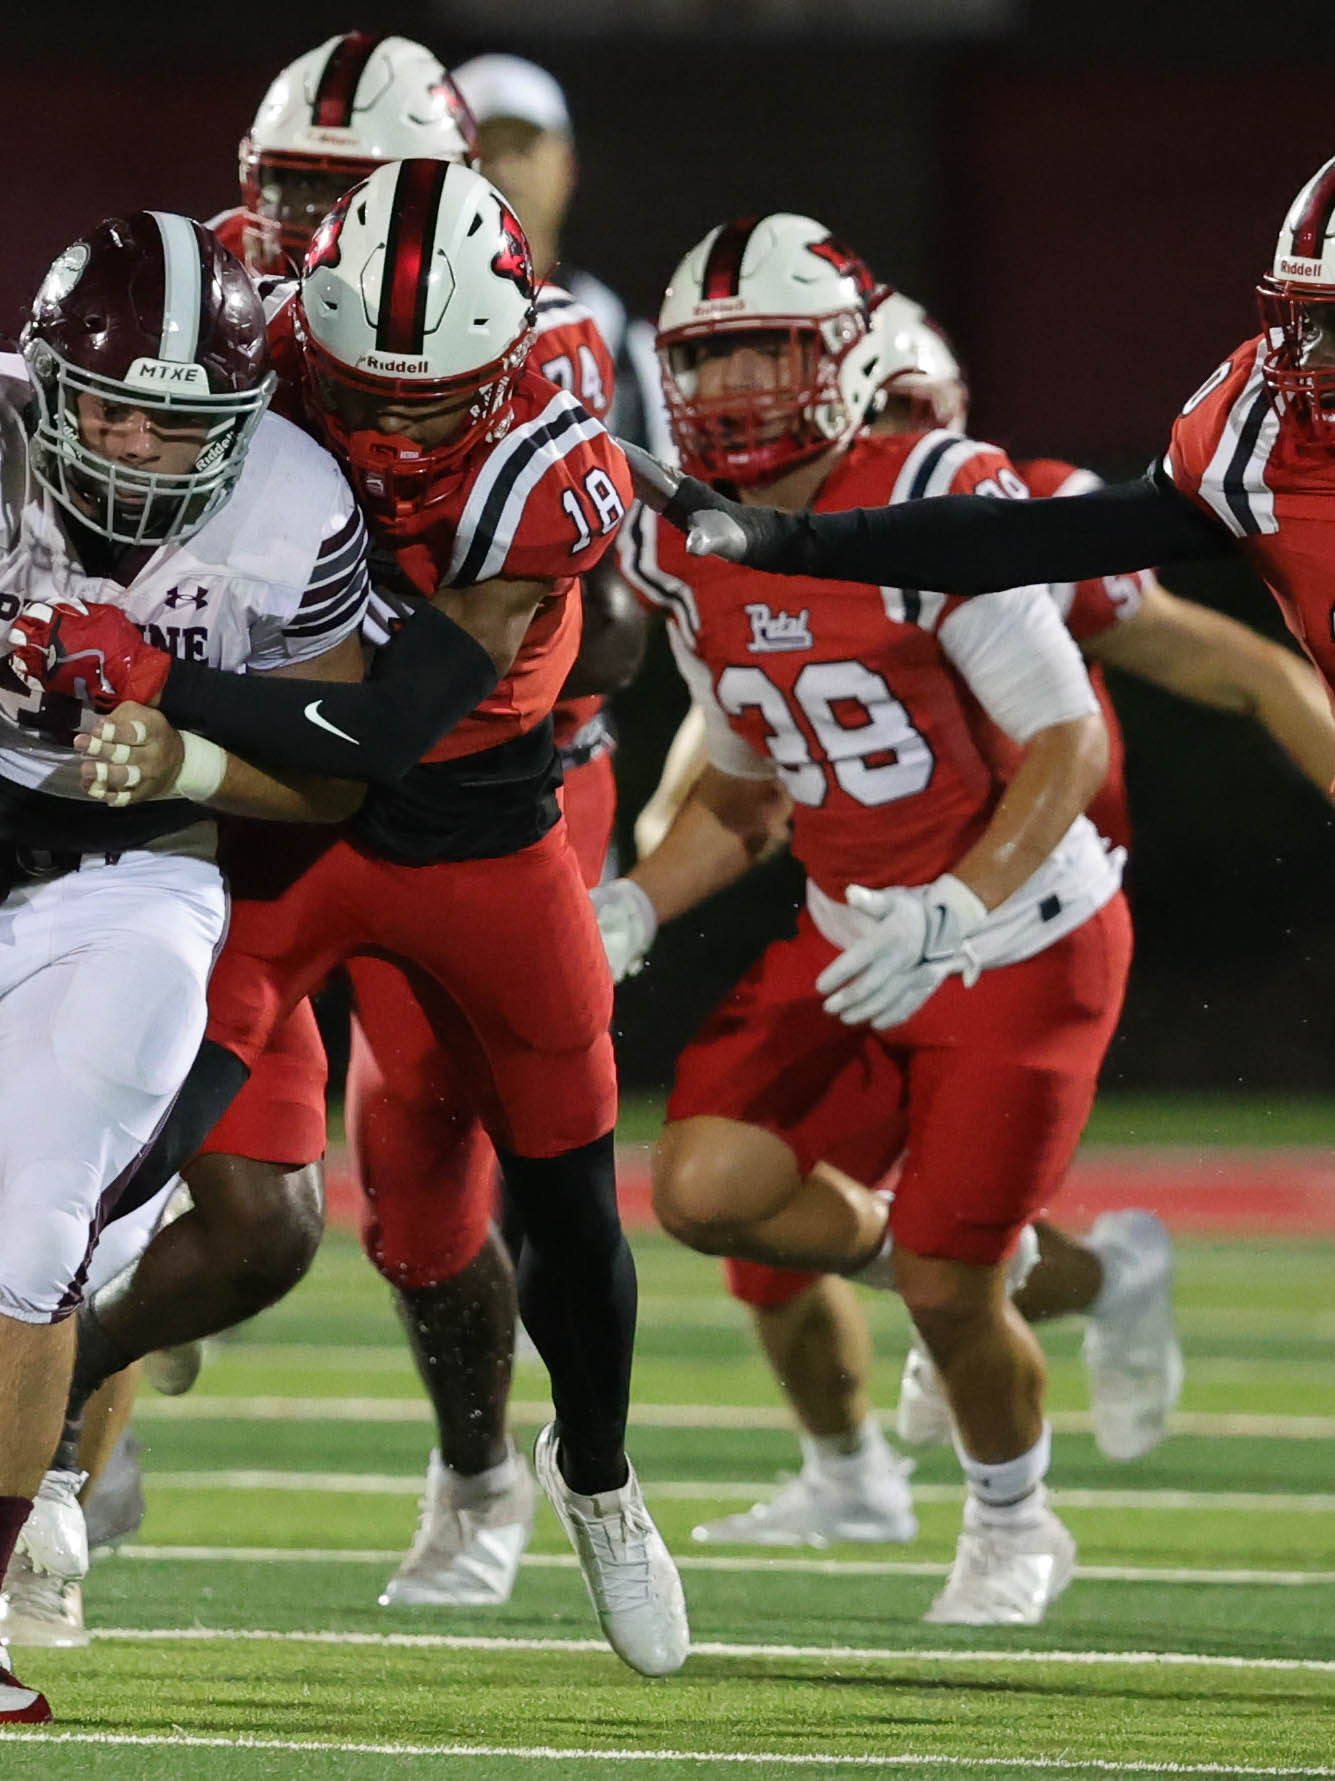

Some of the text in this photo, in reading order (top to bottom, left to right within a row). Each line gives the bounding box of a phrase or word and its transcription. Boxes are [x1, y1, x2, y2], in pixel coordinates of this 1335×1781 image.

[1280, 259, 1322, 277] Riddell
[139, 362, 199, 382] MTXE
[367, 356, 429, 373] Riddell
[541, 344, 607, 410] 74
[195, 431, 234, 472] Riddel
[562, 465, 625, 555] 18
[716, 660, 936, 808] 38
